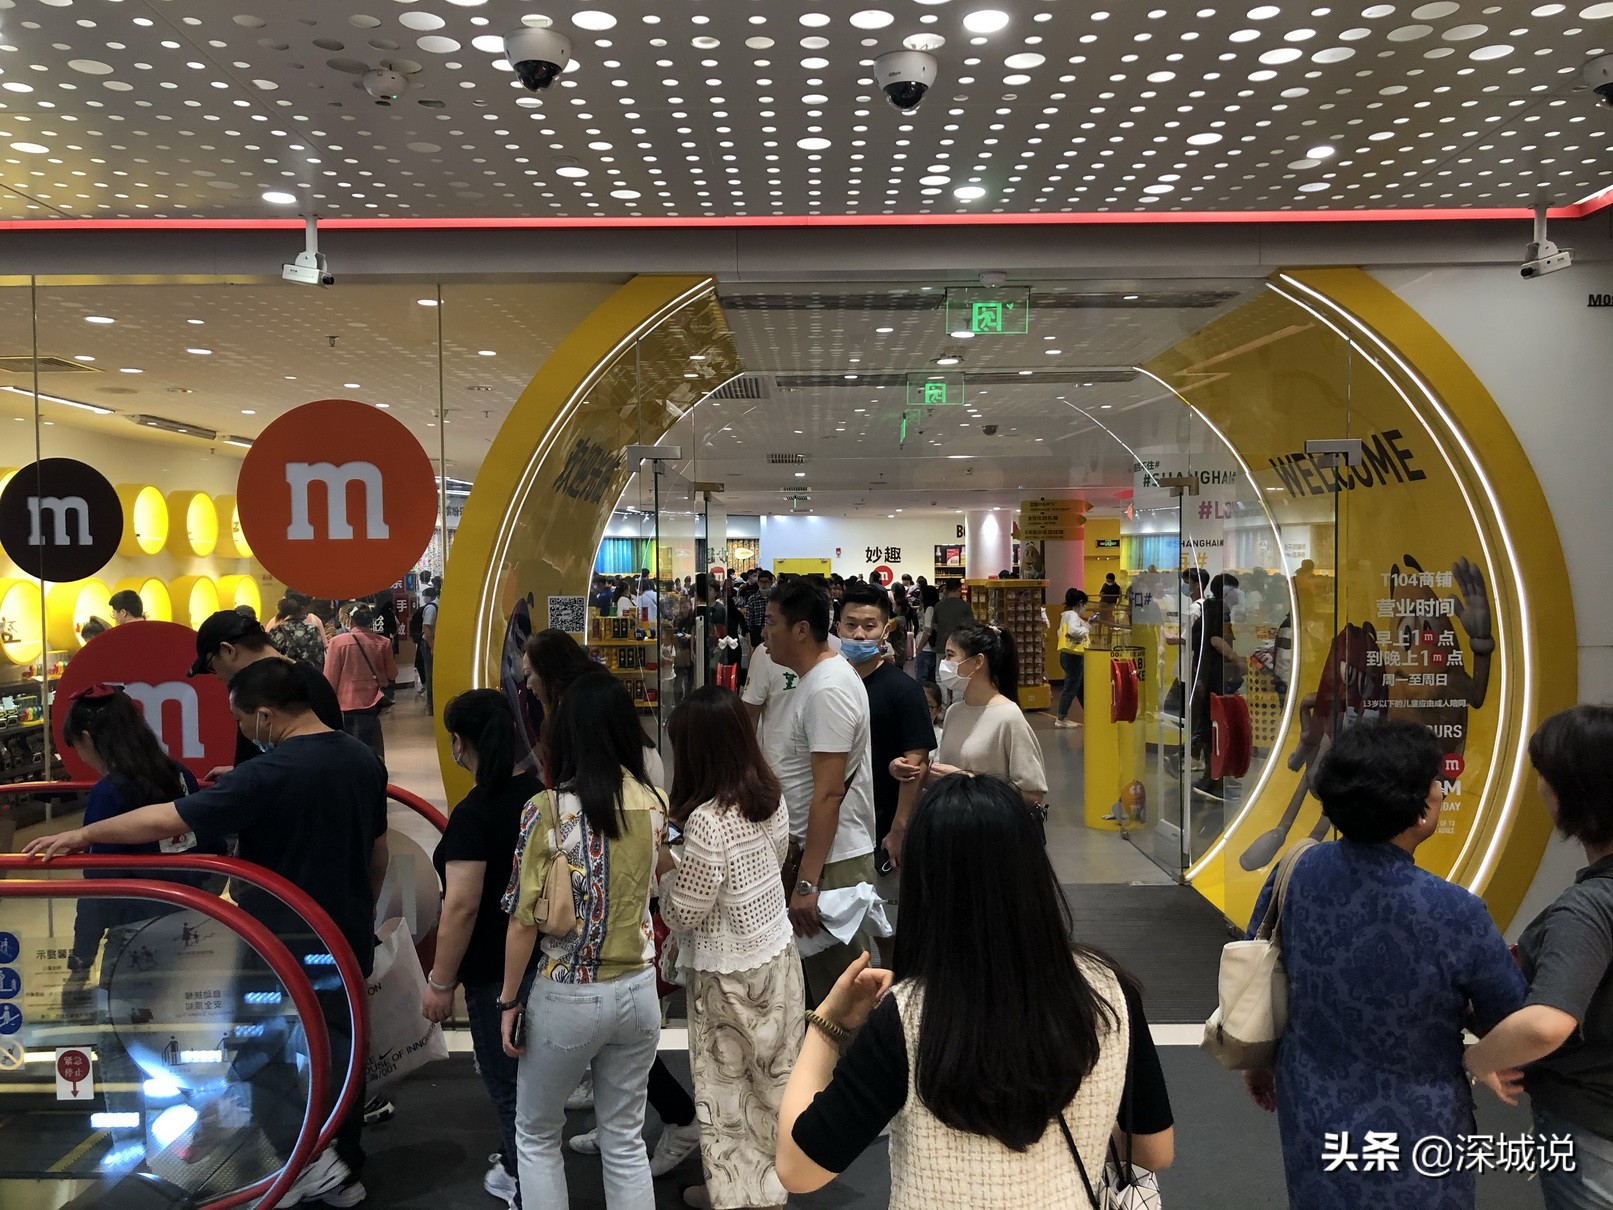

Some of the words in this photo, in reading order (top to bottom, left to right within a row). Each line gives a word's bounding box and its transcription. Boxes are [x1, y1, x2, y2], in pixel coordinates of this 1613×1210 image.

[286, 461, 389, 540] m
[27, 496, 94, 546] m
[865, 546, 902, 563] 妙趣
[1380, 571, 1453, 588] T104商铺
[1376, 598, 1455, 618] 营业时间
[1382, 673, 1448, 687] 周一至周日
[1445, 759, 1460, 771] m
